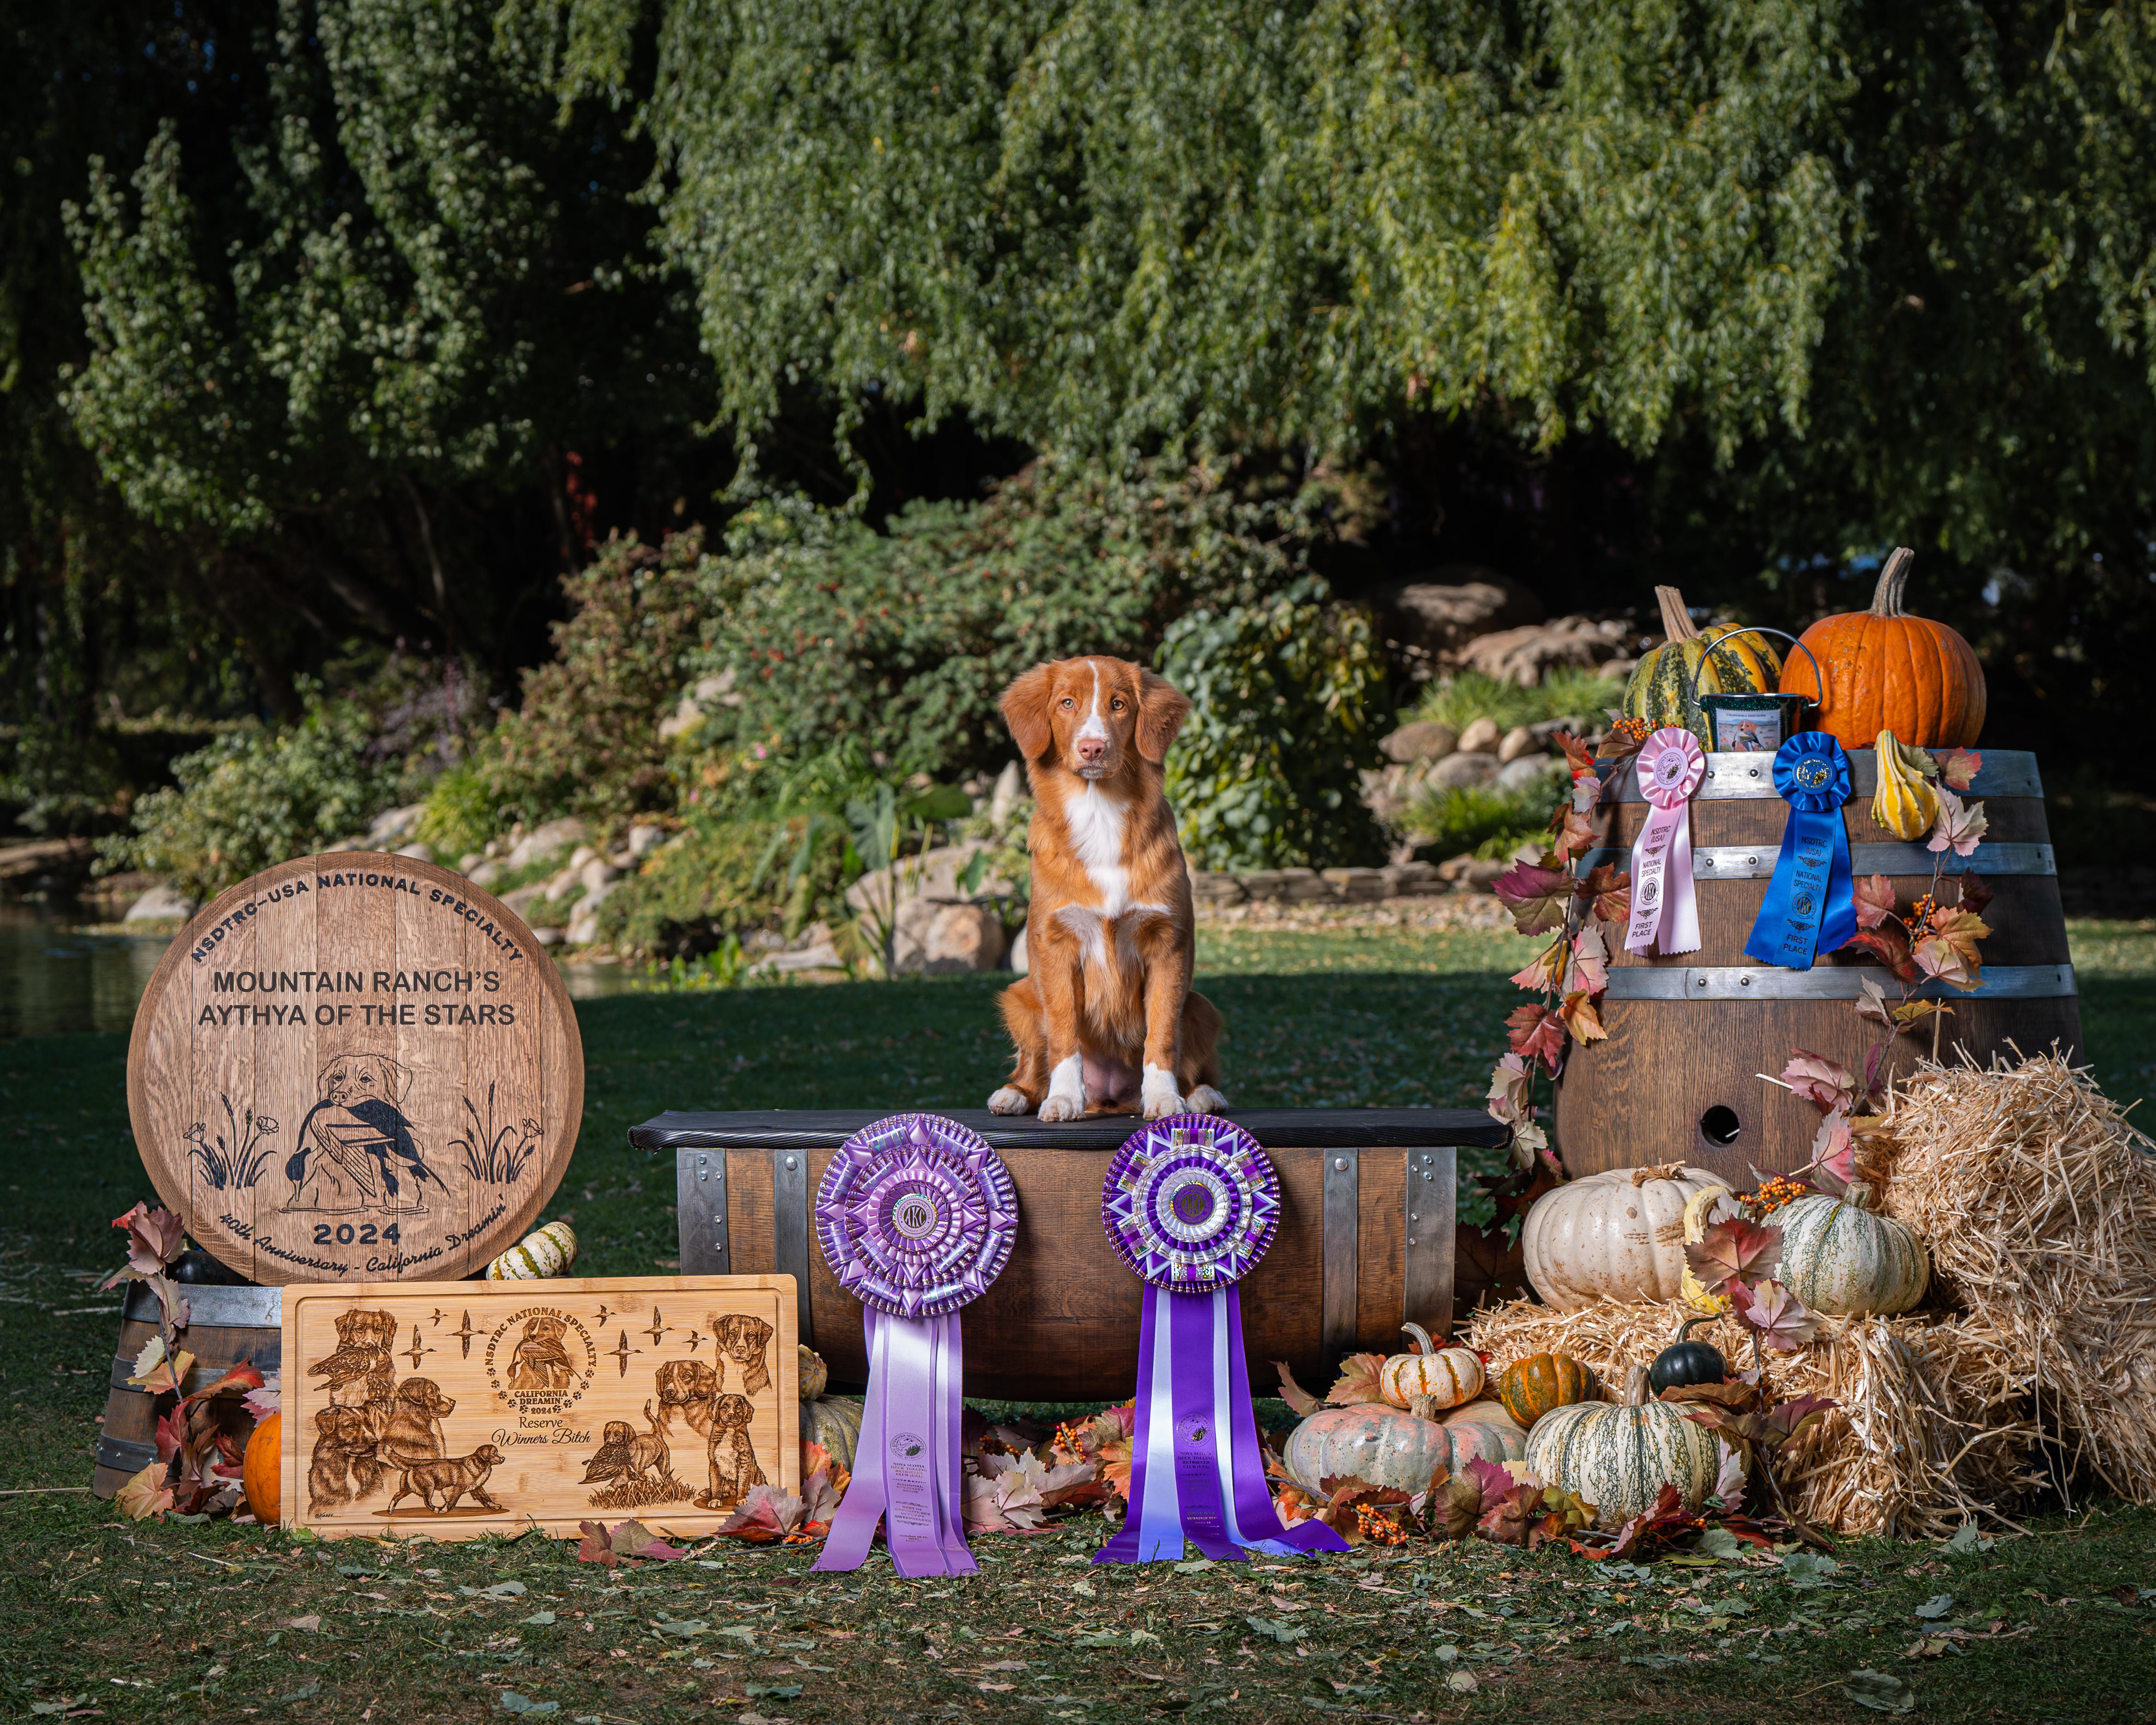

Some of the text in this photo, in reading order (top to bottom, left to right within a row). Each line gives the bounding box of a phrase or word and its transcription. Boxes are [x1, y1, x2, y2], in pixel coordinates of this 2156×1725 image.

[1651, 825, 1671, 836] NSDTRC
[1651, 834, 1665, 844] (USA)
[1801, 836, 1828, 848] NSDTRC
[1806, 847, 1822, 856] (USA)
[1642, 858, 1662, 869] NATIONAL
[1641, 866, 1662, 877] SPECIALTY
[1795, 870, 1822, 883] NATIONAL
[1794, 879, 1822, 892] SPECIALTY
[191, 873, 524, 963] NSDTRC-USA NATIONAL SPECIALTY
[1635, 921, 1653, 930] FIRST
[1632, 929, 1652, 938] PLACE
[1786, 934, 1808, 945] FIRST
[1783, 944, 1808, 955] PLACE
[213, 971, 500, 993] MOUNTAIN RANCH'S
[198, 1004, 515, 1026] AYTHYA OF THE STARS
[899, 1201, 912, 1218] AMERICAN
[912, 1200, 927, 1209] KENNEL
[1183, 1193, 1204, 1215] AKC
[905, 1205, 926, 1228] AKC
[219, 1213, 254, 1240] 40th
[253, 1236, 349, 1278] Anniversary
[366, 1246, 444, 1274] California
[445, 1193, 506, 1251] Dreamin'
[314, 1222, 401, 1245] 2024
[485, 1307, 597, 1367] NSDTRC NATIONAL SPECIALTY
[514, 1390, 569, 1398] CALIFORNIA
[518, 1416, 563, 1429] Reserve
[491, 1428, 591, 1447] Winners Bitch
